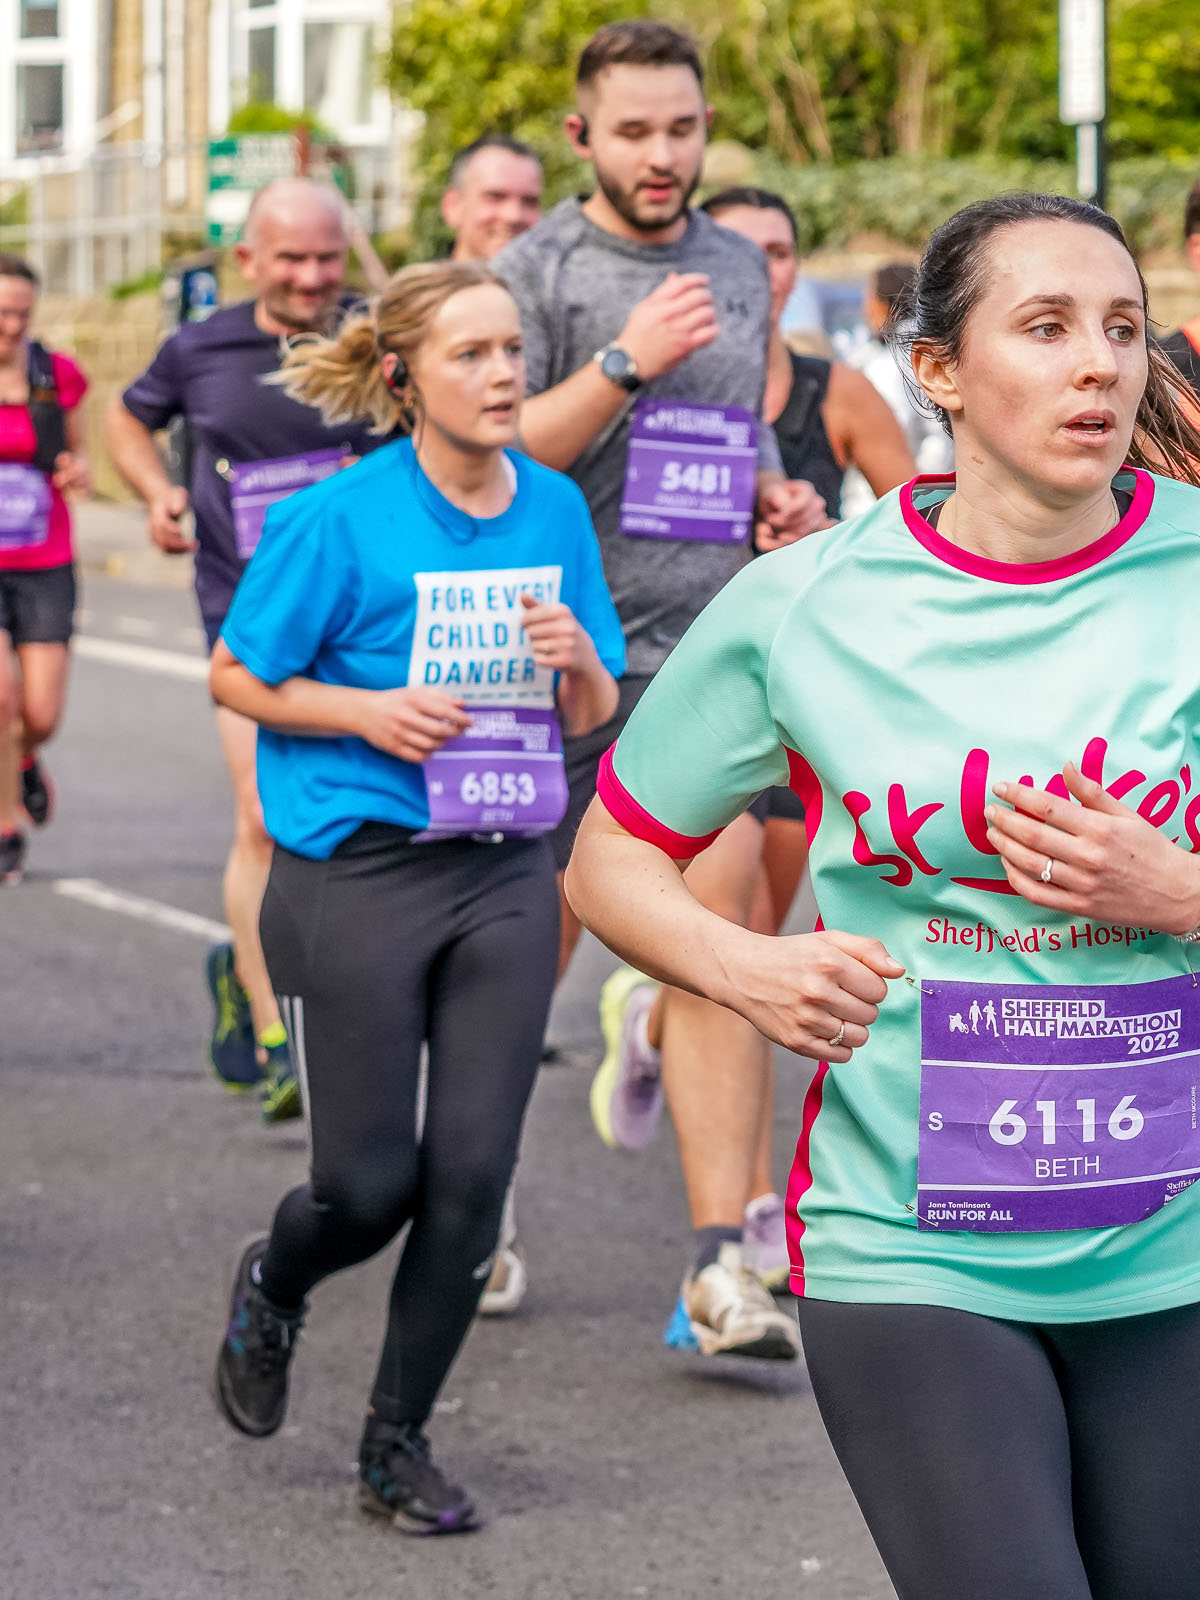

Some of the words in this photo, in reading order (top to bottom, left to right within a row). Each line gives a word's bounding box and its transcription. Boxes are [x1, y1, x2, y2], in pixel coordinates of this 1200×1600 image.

[660, 461, 732, 494] 5481
[431, 586, 475, 612] FOR
[487, 582, 553, 611] EVER
[428, 623, 508, 649] CHILD
[424, 657, 536, 685] DANGER
[461, 771, 537, 806] 6853
[1070, 923, 1161, 948] Hospi
[1004, 1000, 1103, 1018] SHEFFIELD
[1004, 1019, 1056, 1037] HALF
[1060, 1011, 1179, 1037] MARATHON
[1127, 1031, 1180, 1055] 2022
[927, 1111, 944, 1131] S
[988, 1095, 1145, 1146] 6116
[1035, 1155, 1100, 1178] BETH
[927, 1210, 957, 1220] RUN
[959, 1210, 987, 1221] FOR
[989, 1210, 1014, 1221] ALL
[947, 1201, 992, 1209] Tomlinson's
